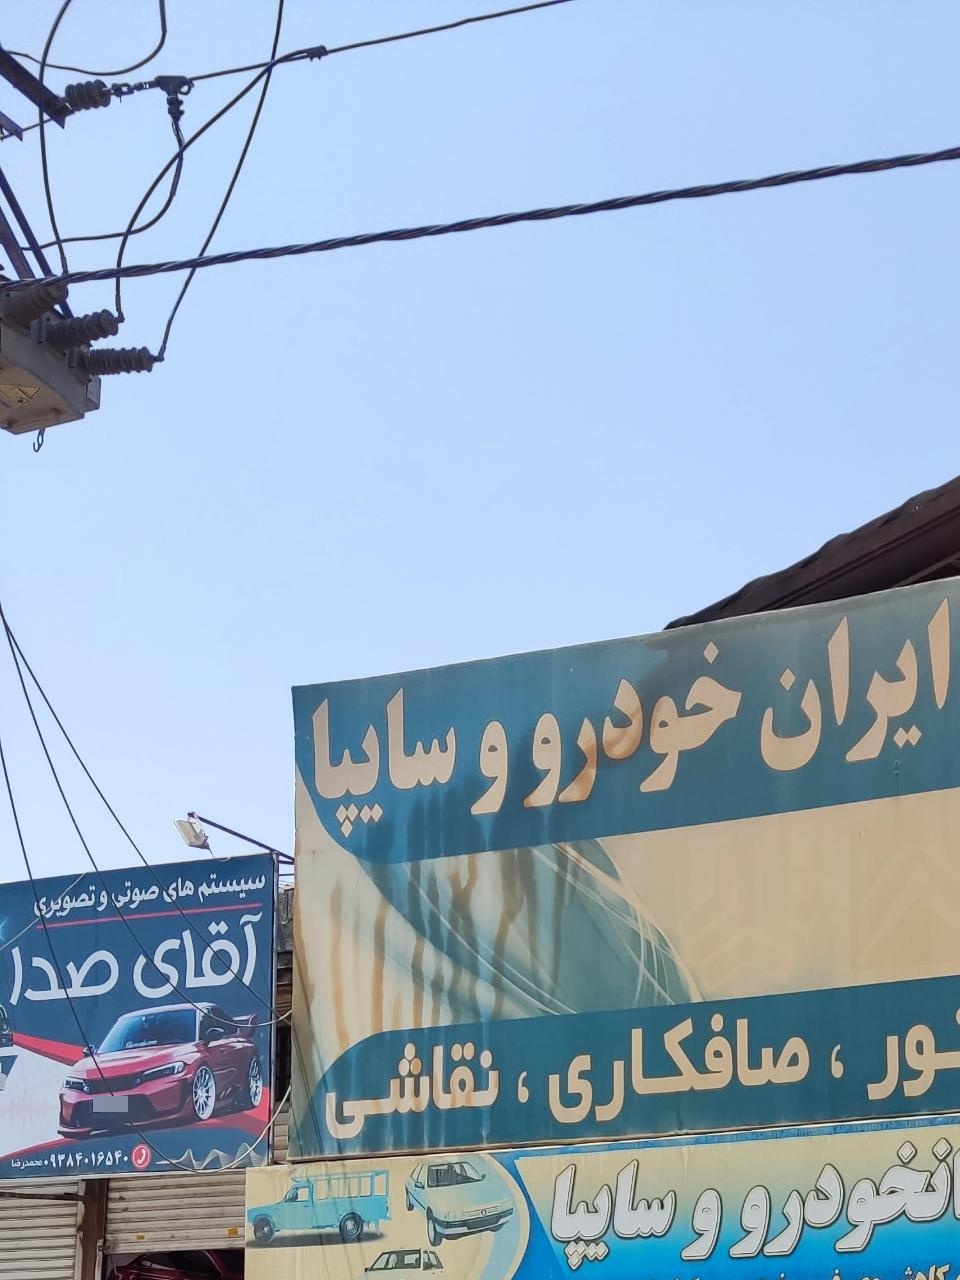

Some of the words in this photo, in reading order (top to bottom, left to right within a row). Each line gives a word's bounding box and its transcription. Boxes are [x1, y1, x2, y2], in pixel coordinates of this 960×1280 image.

[523, 641, 742, 808] خودرو
[759, 596, 951, 772] ایران
[311, 688, 456, 838] سایپا
[470, 718, 508, 815] و
[33, 885, 96, 918] تصویری
[97, 889, 108, 912] و
[112, 880, 160, 909] صوتی
[162, 876, 194, 903] های
[198, 872, 266, 902] سیستم
[9, 946, 119, 1006] صدا
[133, 911, 263, 999] آقای
[325, 1042, 500, 1139] نقاشی
[548, 1013, 810, 1123] صافکاری
[11, 1158, 43, 1170] محمدرضا
[551, 1158, 677, 1270] سایپا
[681, 1187, 723, 1261] و
